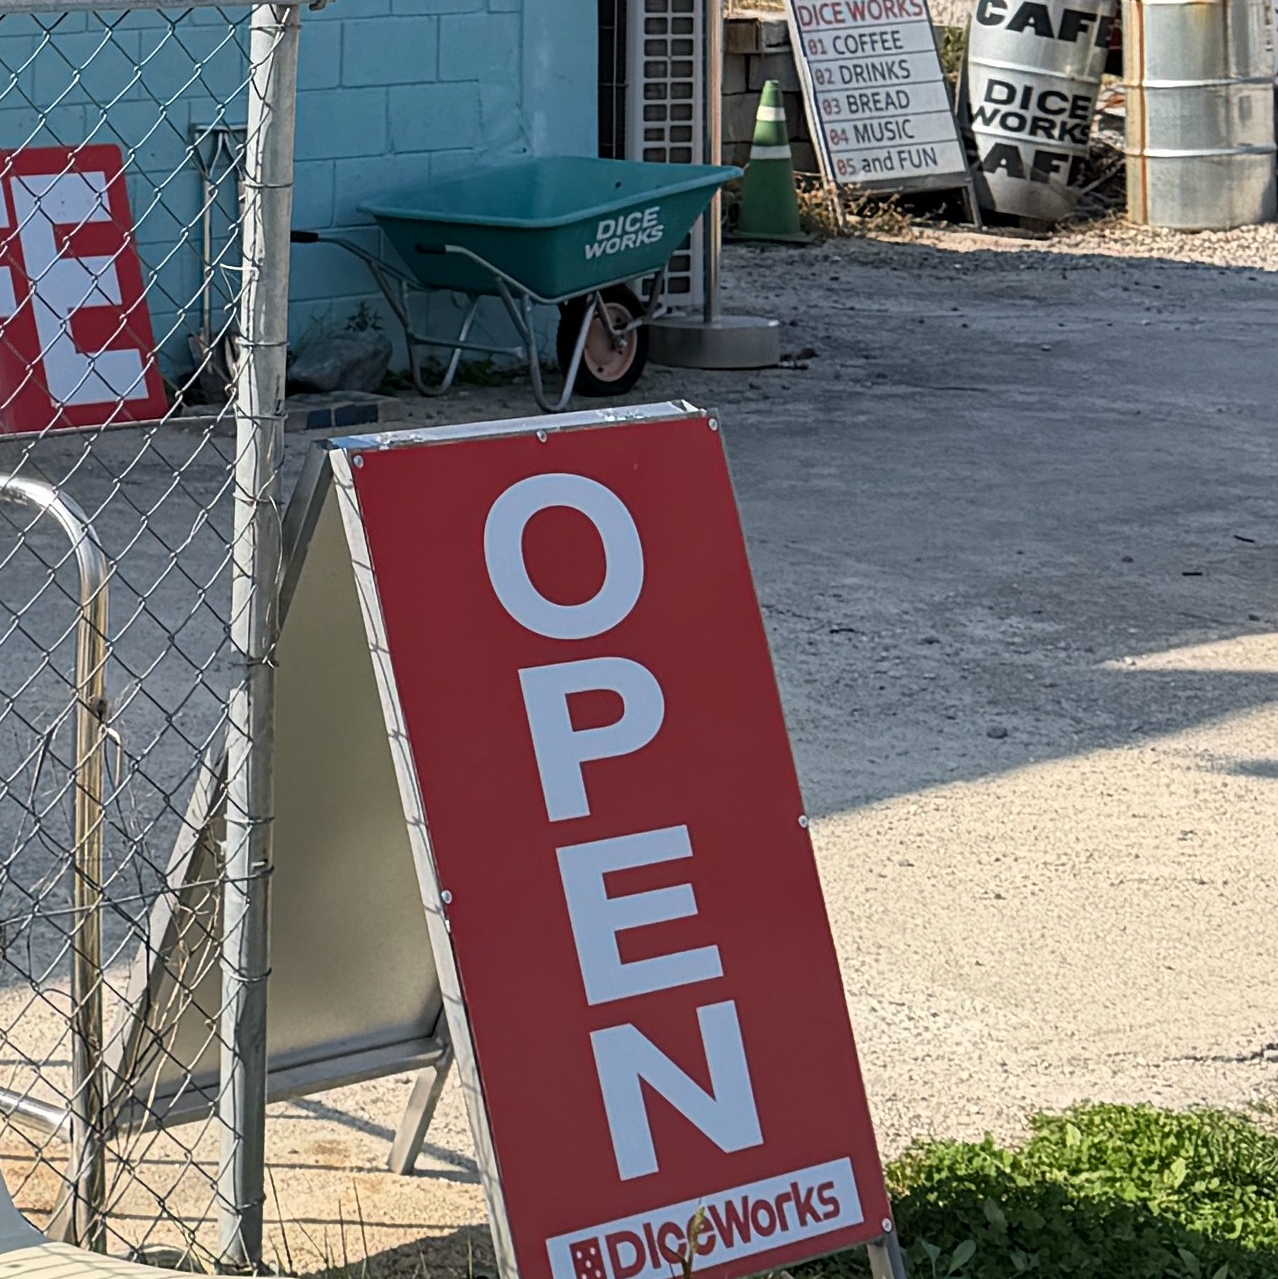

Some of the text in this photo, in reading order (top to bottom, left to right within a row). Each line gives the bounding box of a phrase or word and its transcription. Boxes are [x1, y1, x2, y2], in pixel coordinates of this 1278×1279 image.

[797, 1, 845, 27] DICE
[807, 30, 904, 56] 01 COFFEE
[815, 59, 911, 86] 02 DRINKS
[822, 89, 911, 115] 03 BREAD
[983, 78, 1092, 120] DICE
[829, 118, 915, 146] 04 MUSIC
[837, 146, 938, 176] 05 and FUN
[596, 206, 661, 241] DICE
[585, 225, 664, 260] WORKS
[482, 472, 767, 1182] OPEN
